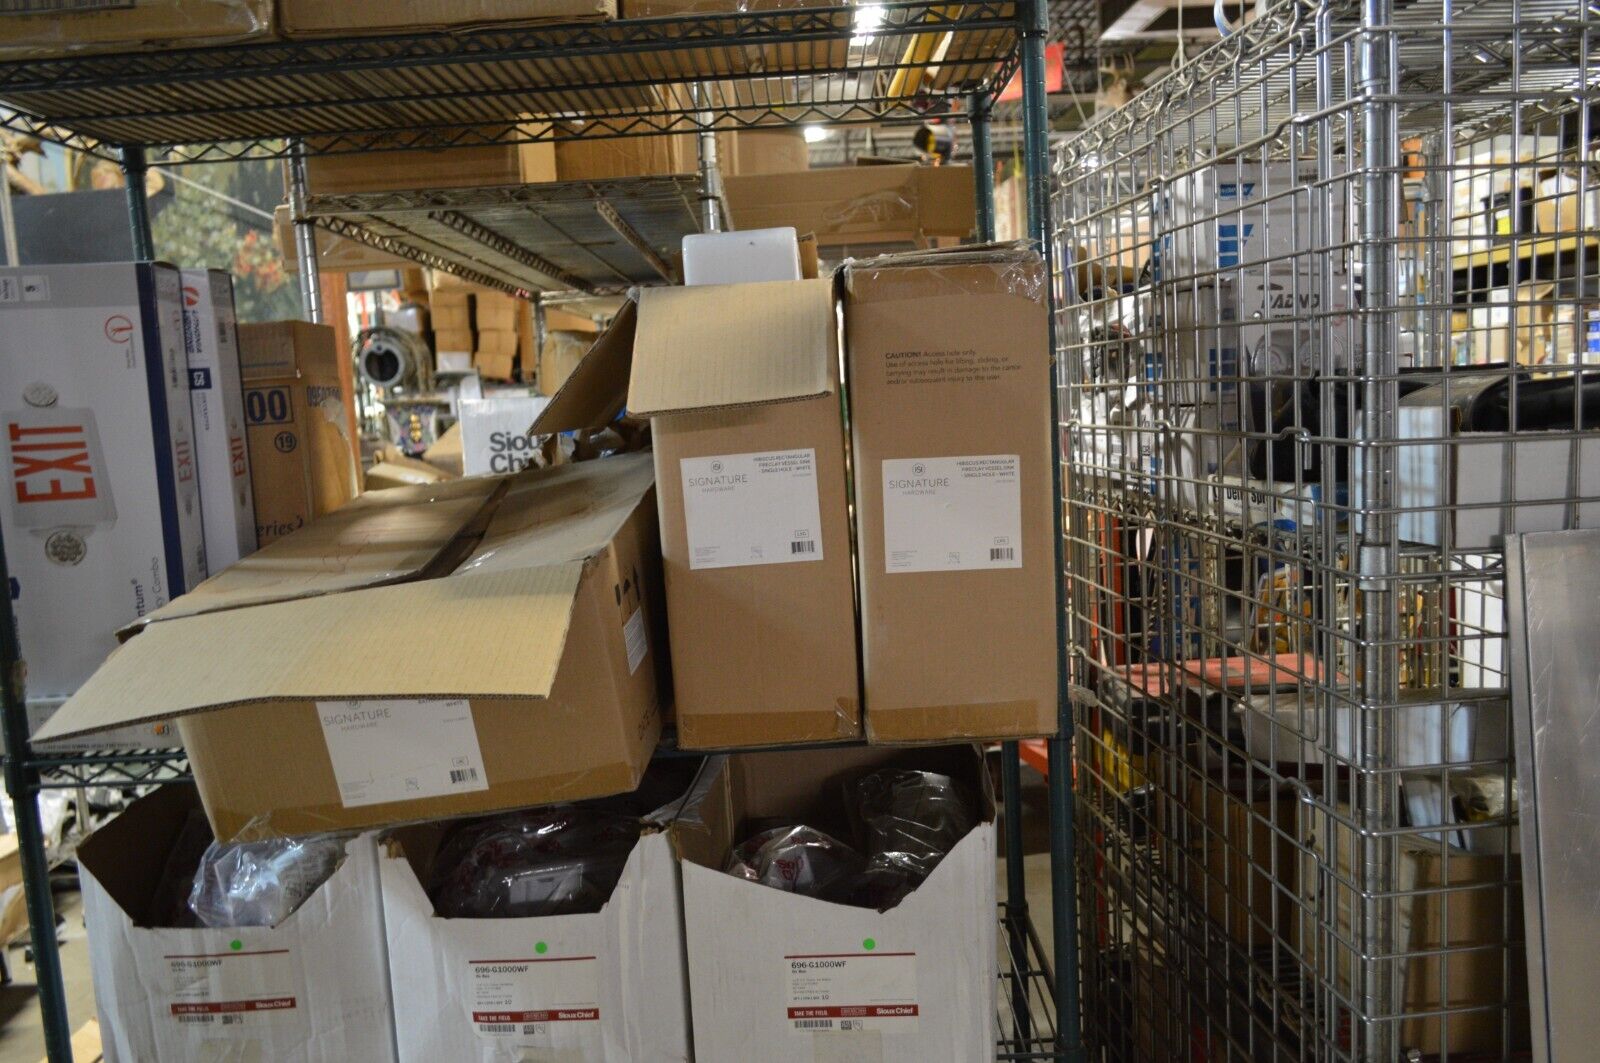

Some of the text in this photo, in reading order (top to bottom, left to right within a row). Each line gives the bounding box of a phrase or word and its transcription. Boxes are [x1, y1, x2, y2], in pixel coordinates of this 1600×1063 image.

[490, 431, 546, 453] Siou
[8, 422, 97, 503] EXIT
[176, 438, 193, 484] EXIT
[229, 437, 247, 478] EXIT
[688, 474, 749, 487] SIGNATURE
[889, 477, 950, 490] SIGNATURE
[701, 485, 735, 493] HARDWARE
[323, 708, 392, 727] SIGNATURE
[475, 965, 528, 974] 696-G1000WF
[791, 960, 846, 969] 696-G1000WF
[896, 1006, 914, 1014] Chief
